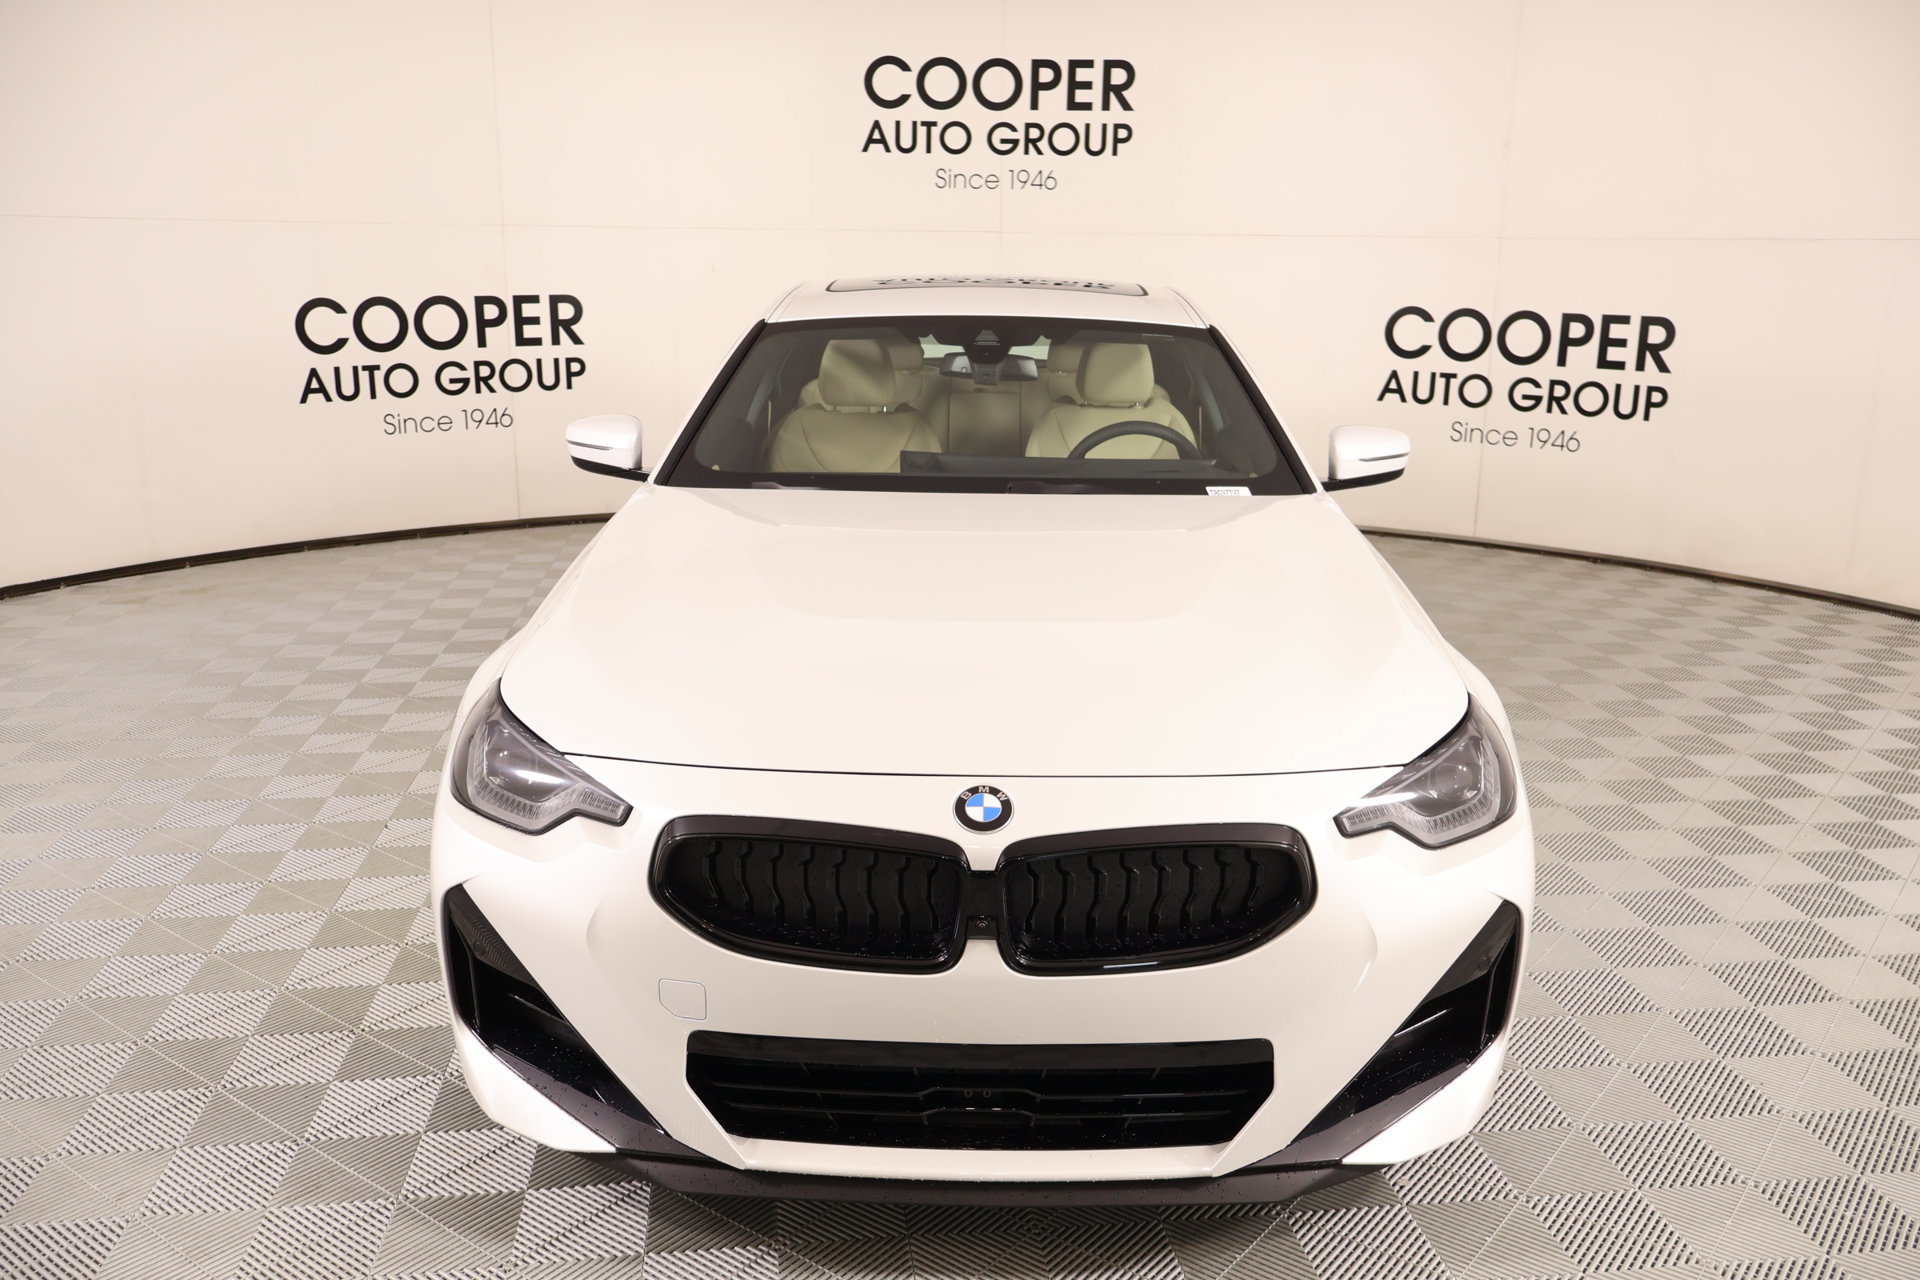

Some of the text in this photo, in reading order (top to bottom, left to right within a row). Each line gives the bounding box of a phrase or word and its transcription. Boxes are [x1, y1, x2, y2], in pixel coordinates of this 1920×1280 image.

[864, 55, 1136, 111] COOPER
[862, 119, 1134, 157] AUTO GROUP
[935, 167, 1057, 190] Since 1946
[295, 294, 585, 356] COOPER
[1384, 305, 1677, 375] COOPER
[299, 356, 588, 405] AUTO GROUP
[1377, 369, 1669, 422] AUTO GROUP
[383, 407, 514, 435] Since 1946
[1449, 420, 1581, 453] Since 1946
[959, 785, 1009, 802] BMW
